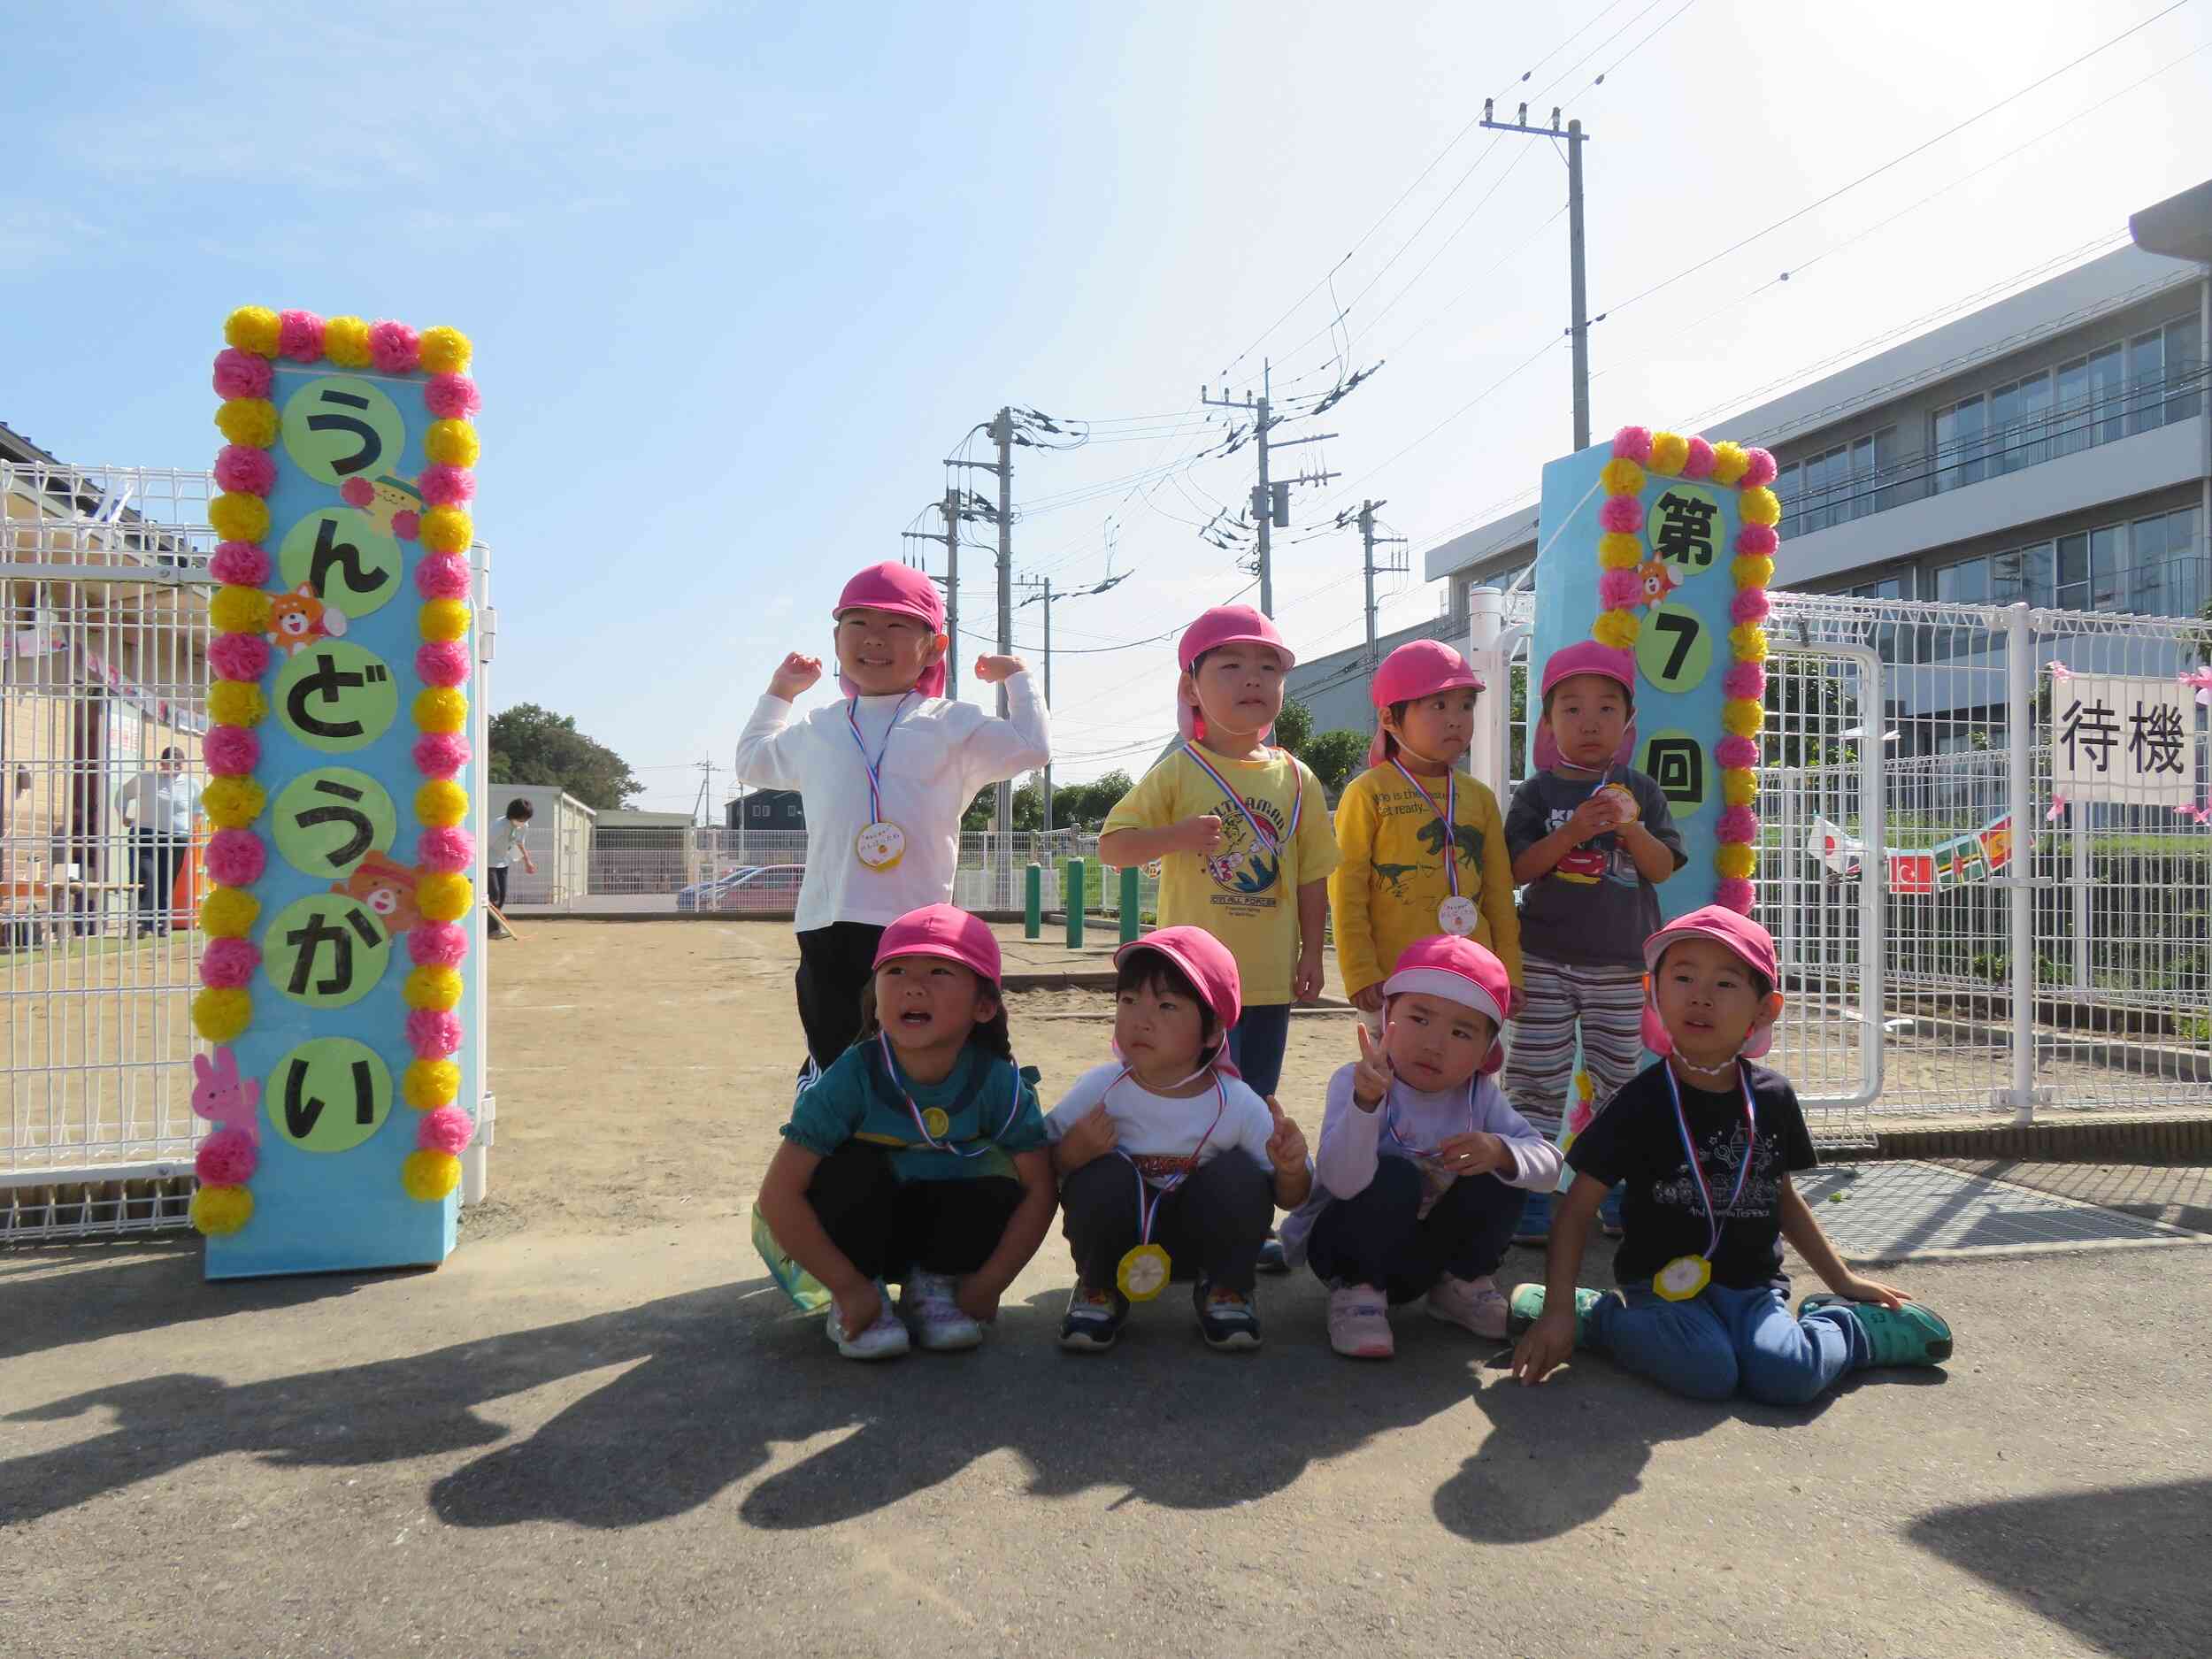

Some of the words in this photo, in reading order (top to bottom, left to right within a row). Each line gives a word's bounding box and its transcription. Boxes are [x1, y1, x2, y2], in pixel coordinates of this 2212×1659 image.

[285, 389, 388, 1139] うんどうかい
[1646, 491, 1718, 803] 第7回
[2060, 698, 2185, 774] 待機
